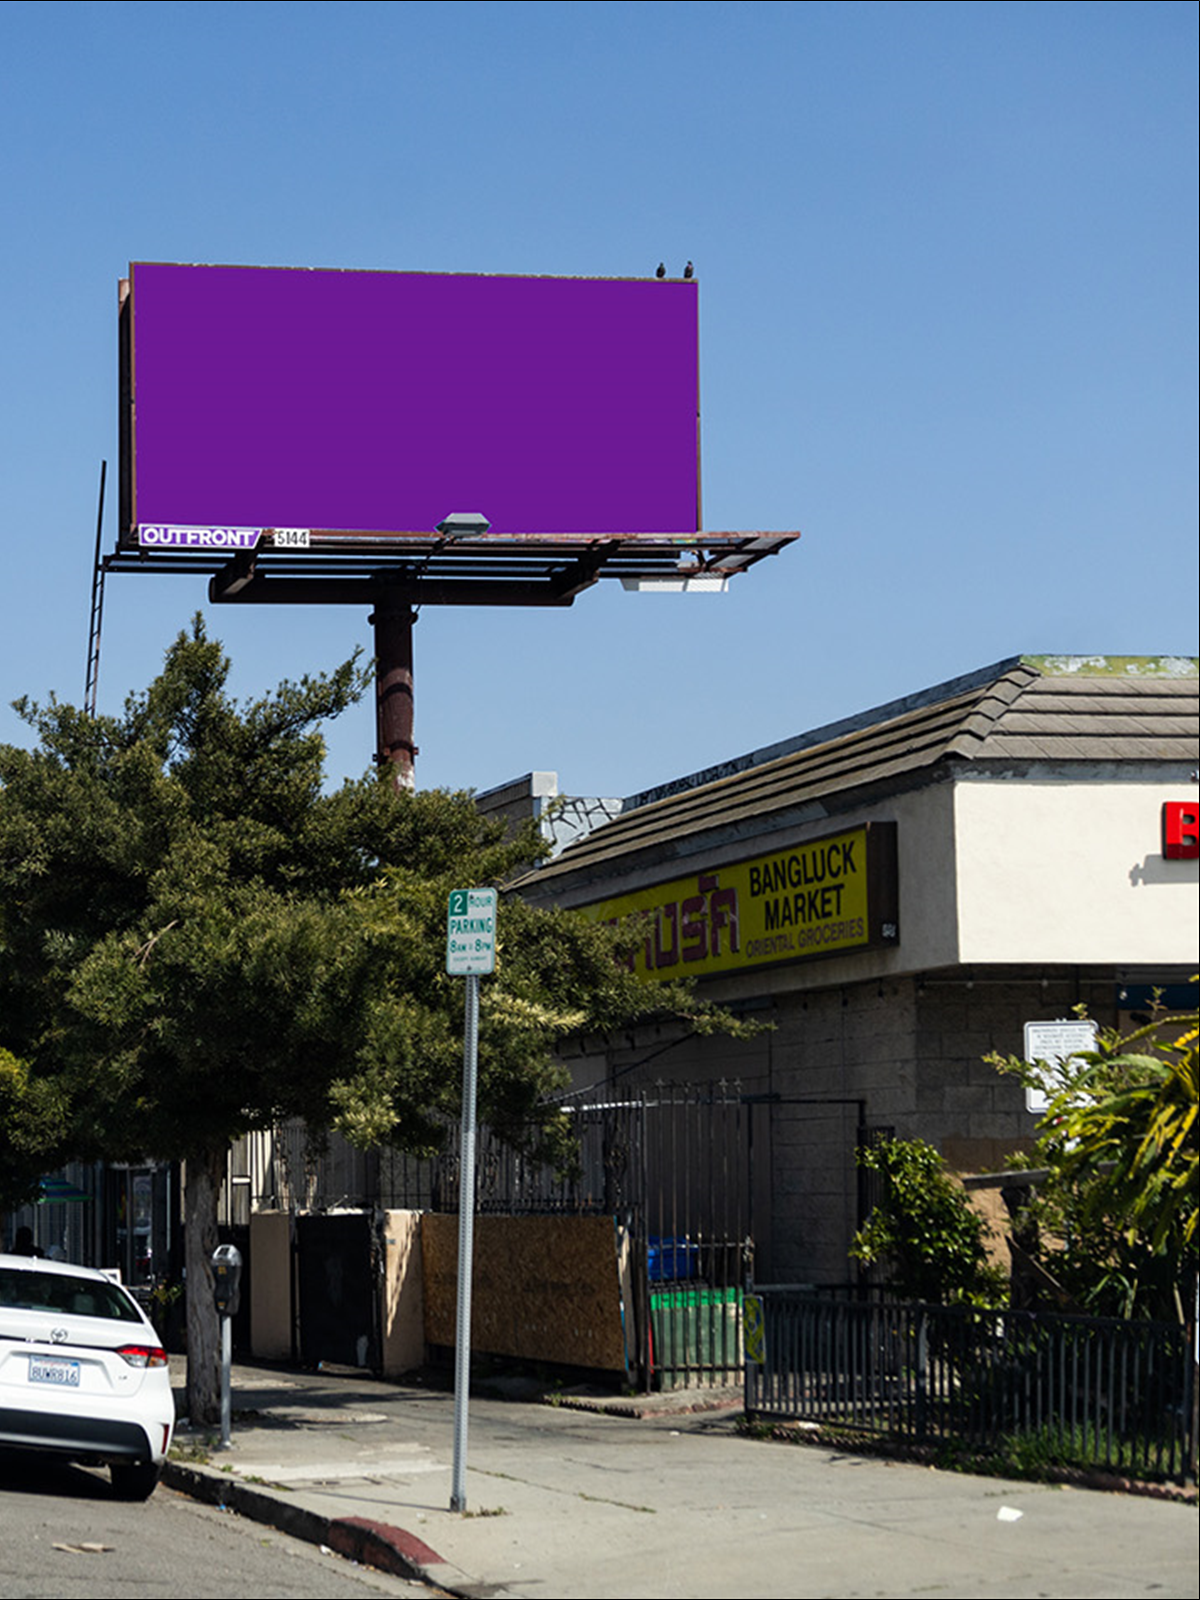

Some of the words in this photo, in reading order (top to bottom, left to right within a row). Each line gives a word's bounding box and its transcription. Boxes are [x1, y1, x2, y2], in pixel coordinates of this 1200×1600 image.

[143, 527, 254, 547] OUTFRONT
[277, 530, 308, 547] 5144
[750, 840, 857, 897] BANGLUCK
[453, 894, 464, 913] 2
[764, 884, 845, 931] MARKET
[450, 917, 493, 935] PARKING
[746, 933, 796, 958] ORIENTAL
[798, 917, 865, 948] GROCERIES
[32, 1366, 78, 1383] 8UWR816
